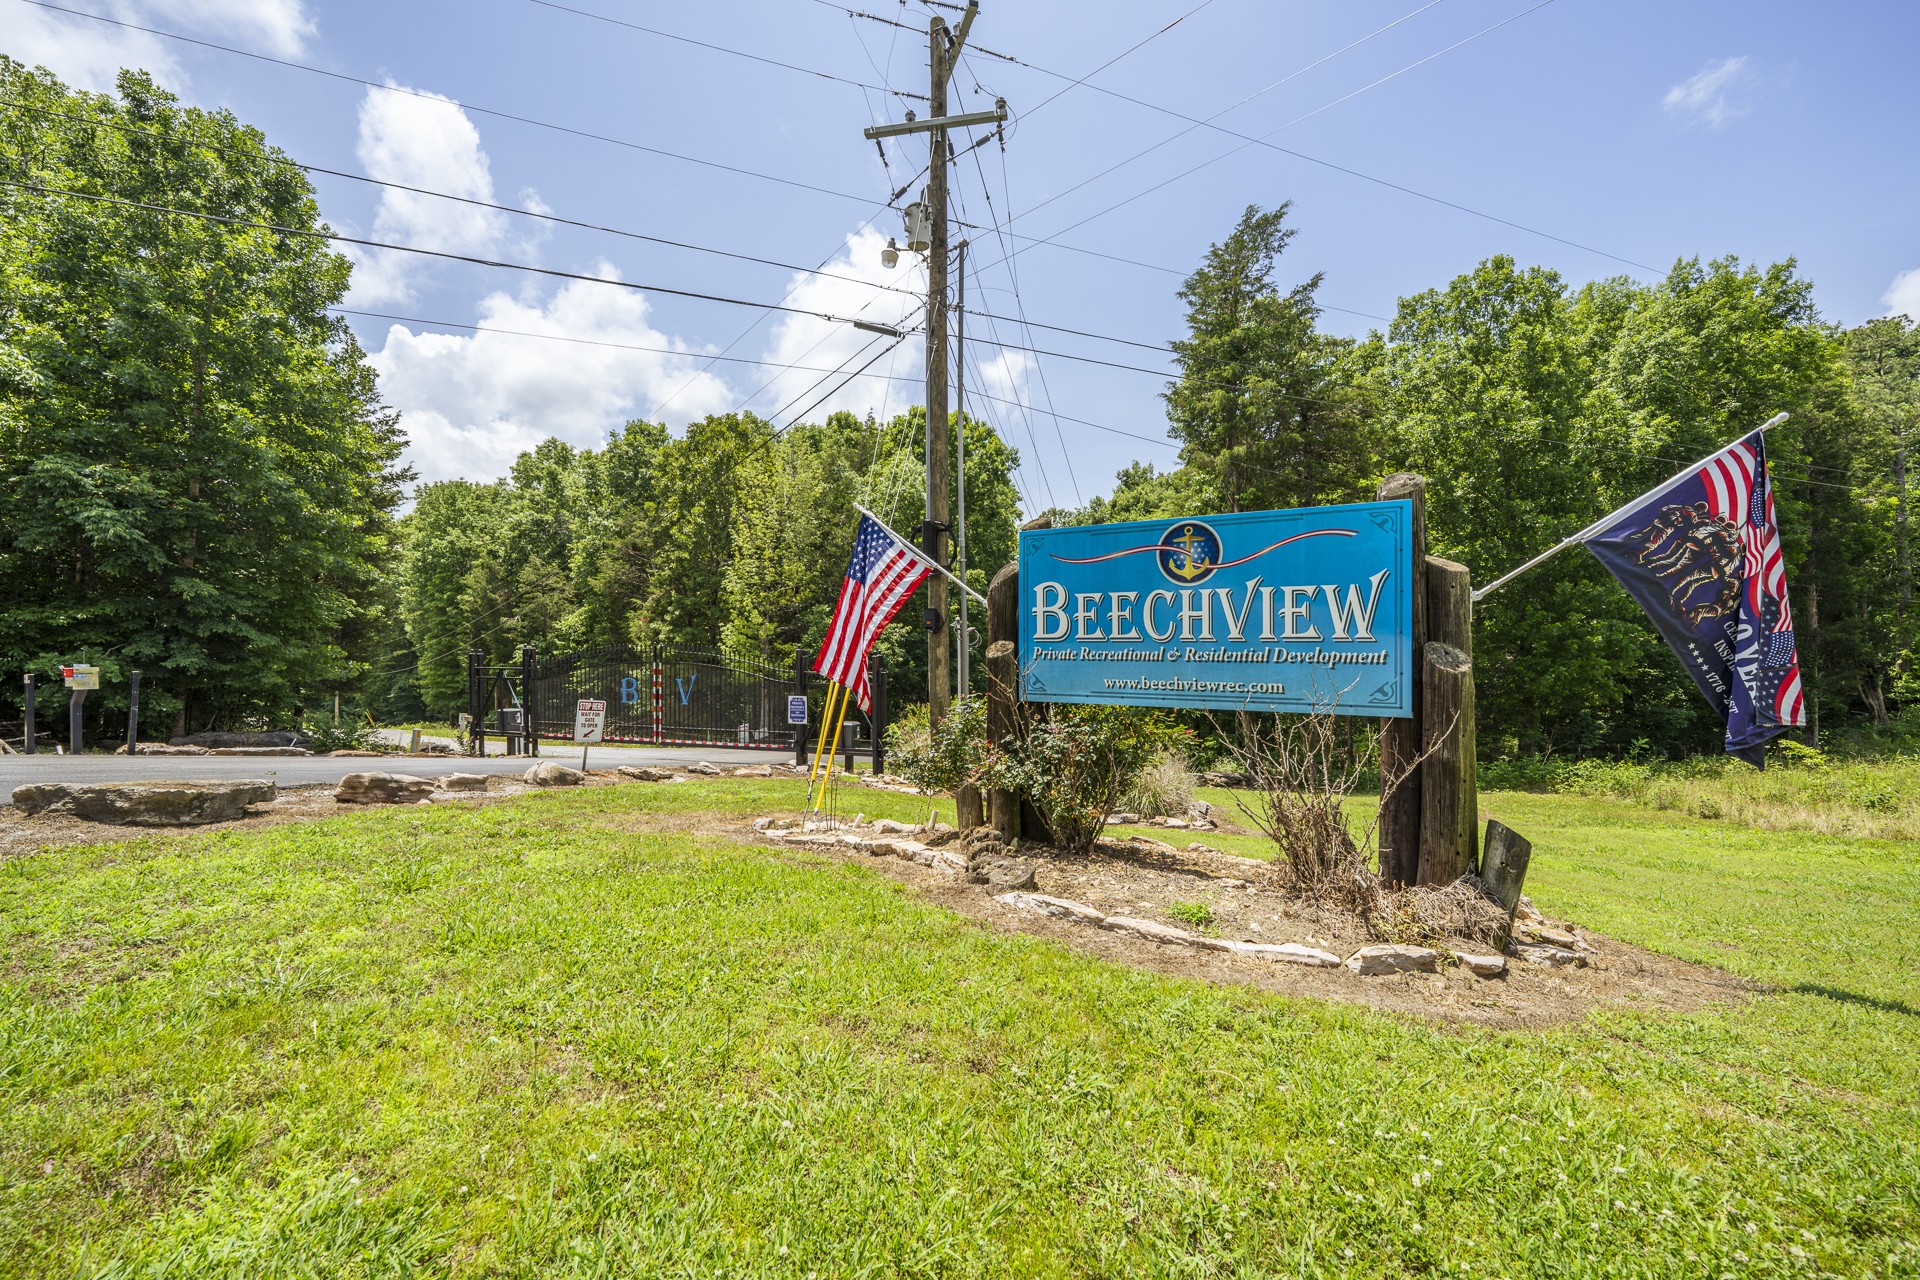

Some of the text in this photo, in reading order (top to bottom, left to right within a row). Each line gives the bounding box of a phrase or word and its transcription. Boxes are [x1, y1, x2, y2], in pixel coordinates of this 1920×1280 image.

[1032, 568, 1391, 643] BEECHVIEW
[1032, 646, 1390, 670] Private Recreational & Residential Development
[620, 674, 697, 705] B V
[1103, 675, 1286, 695] www.beechviewrec.com
[1706, 672, 1726, 692] 1776
[580, 702, 604, 711] STOP HERE
